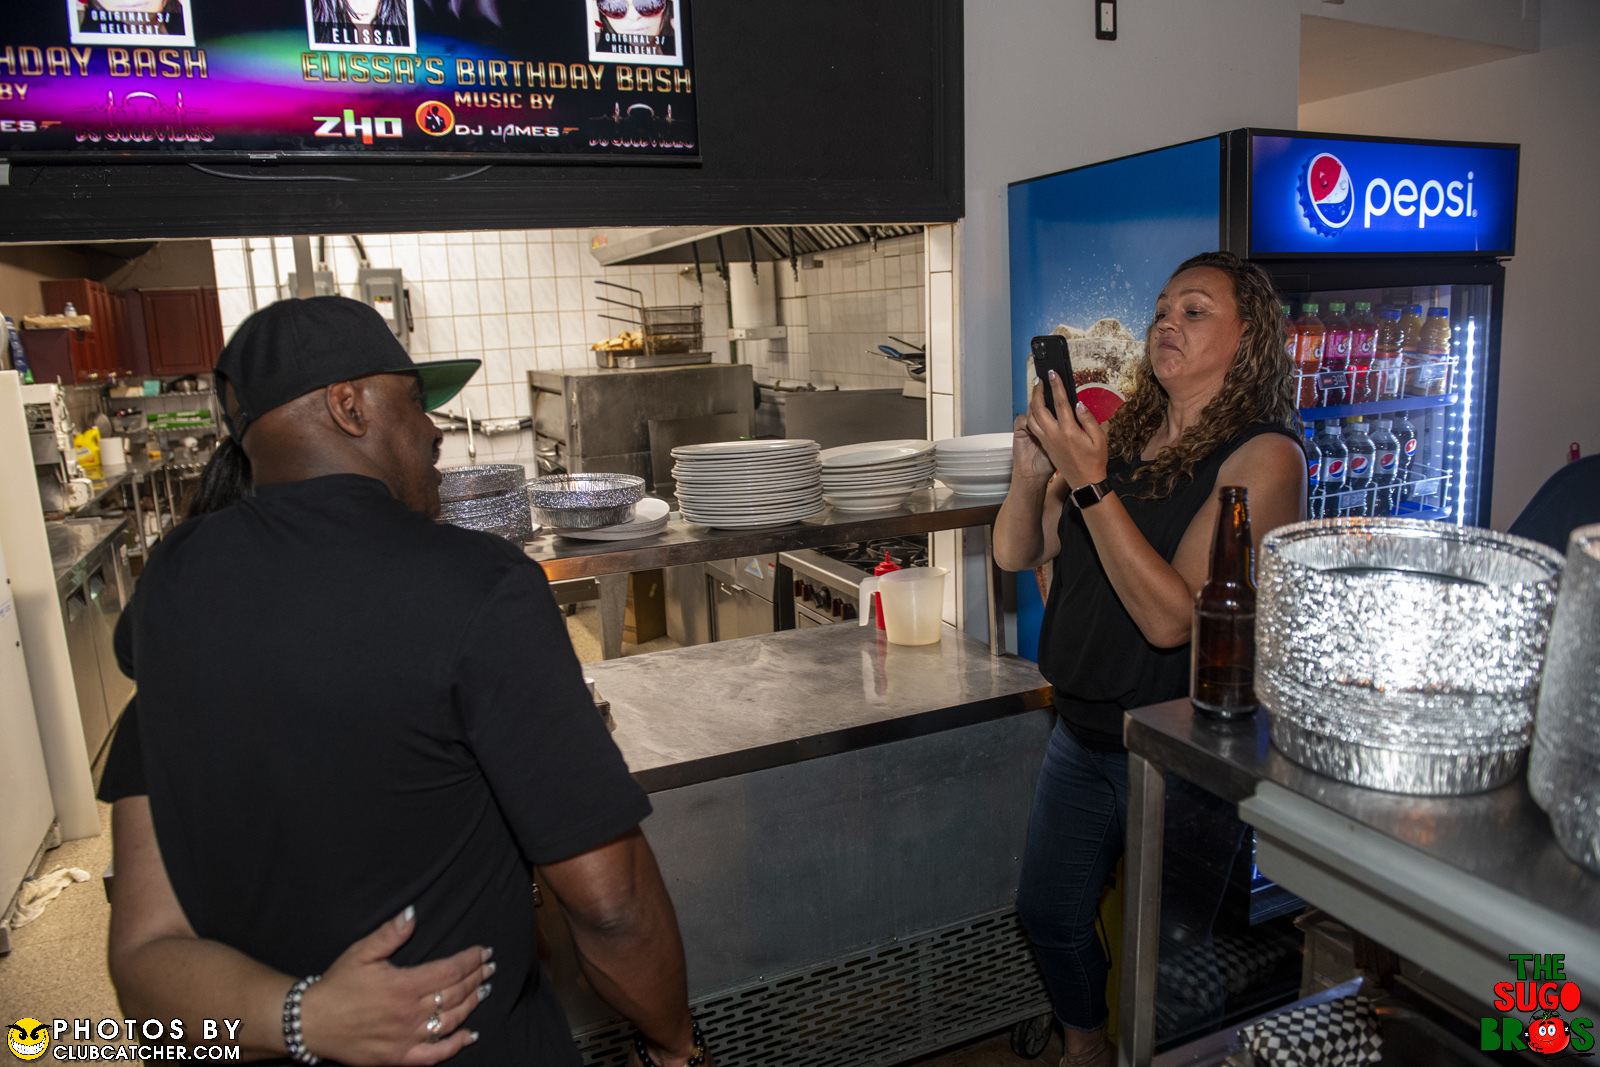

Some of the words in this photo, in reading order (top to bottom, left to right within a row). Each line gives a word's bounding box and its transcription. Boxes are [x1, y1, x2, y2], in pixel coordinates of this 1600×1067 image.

[91, 10, 150, 22] ORIGINAL
[331, 28, 394, 45] ELISSA
[605, 32, 650, 45] ORIGINAL
[107, 47, 208, 78] BASH
[302, 52, 445, 85] ELISSA'S
[455, 58, 605, 91] BIRTHDAY
[616, 65, 693, 93] BASH
[454, 91, 523, 109] MUSIC
[529, 93, 555, 109] BY
[454, 124, 483, 136] DJ
[490, 123, 560, 143] JAMES
[1363, 171, 1474, 229] pepsi
